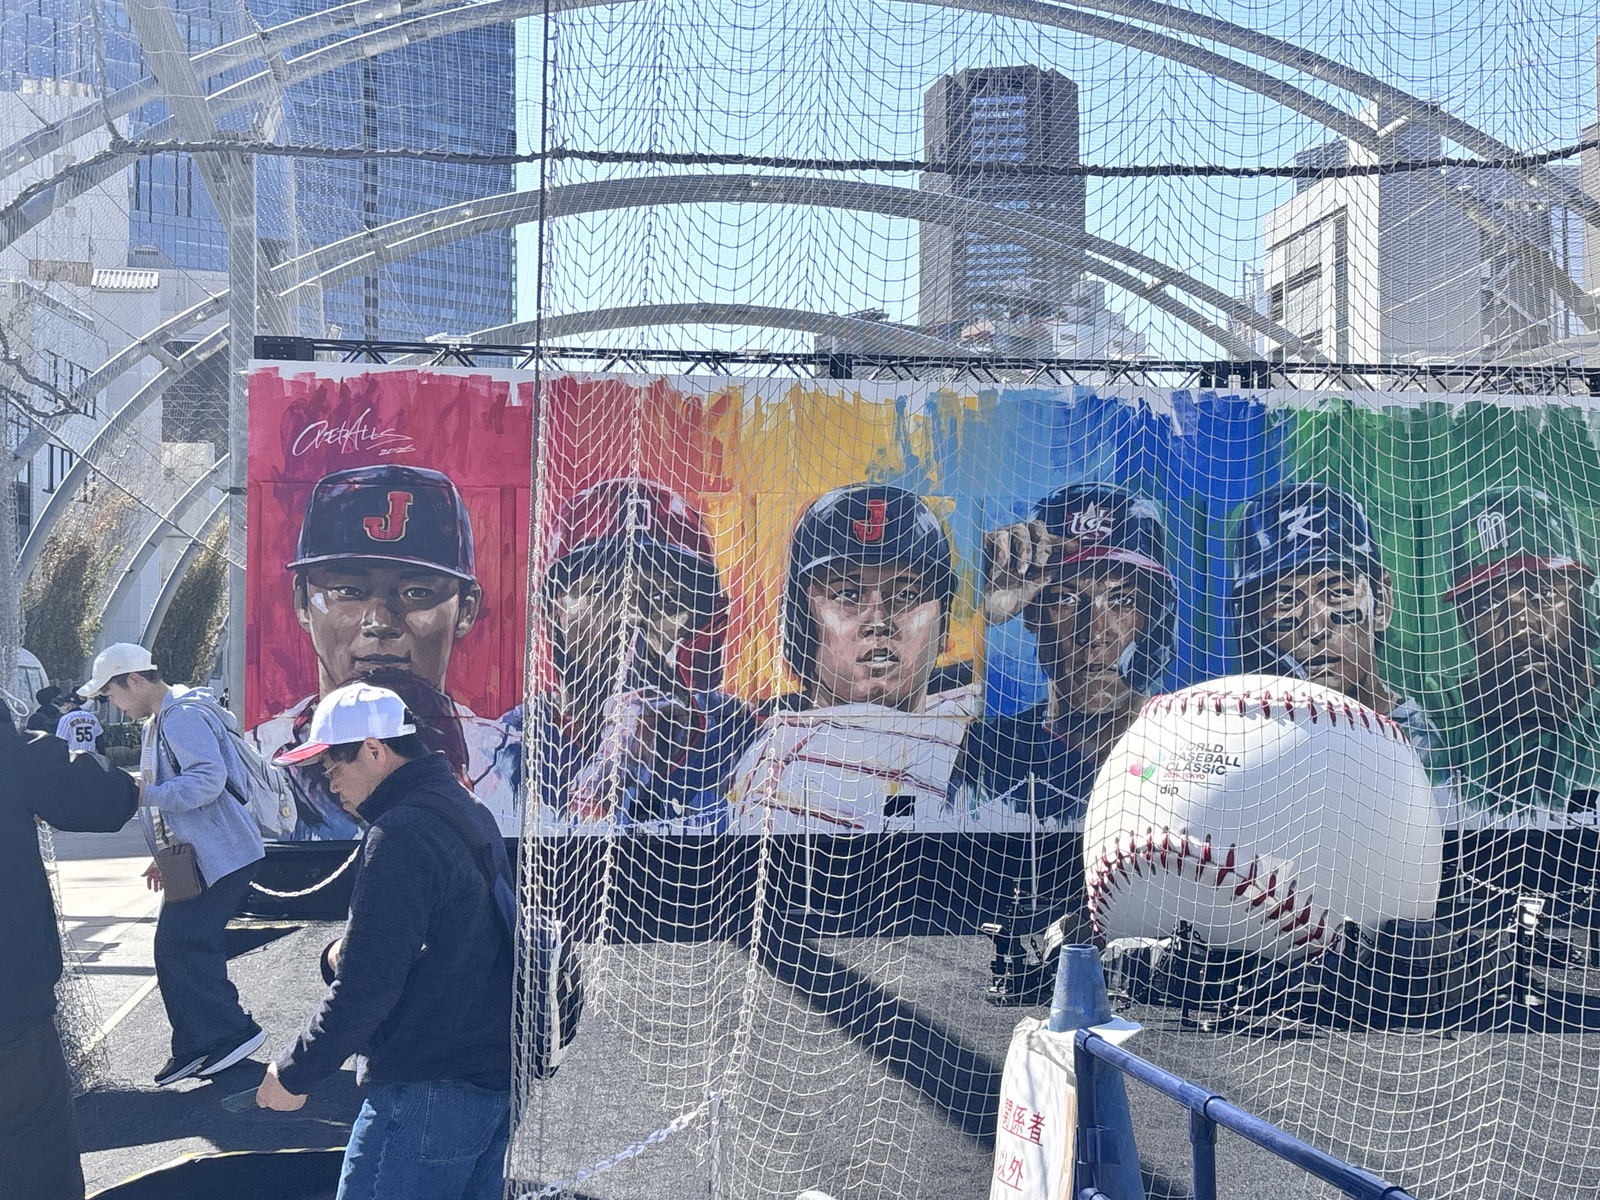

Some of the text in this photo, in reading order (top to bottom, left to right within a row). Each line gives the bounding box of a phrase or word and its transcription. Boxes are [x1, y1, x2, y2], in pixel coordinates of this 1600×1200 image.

[378, 443, 417, 456] 2026
[362, 490, 414, 542] J
[852, 498, 889, 544] J
[75, 725, 94, 743] 55
[1165, 761, 1227, 776] CLASSIC
[1181, 772, 1206, 780] TOKYO
[1159, 783, 1179, 797] dip
[997, 1150, 1024, 1187] 以外
